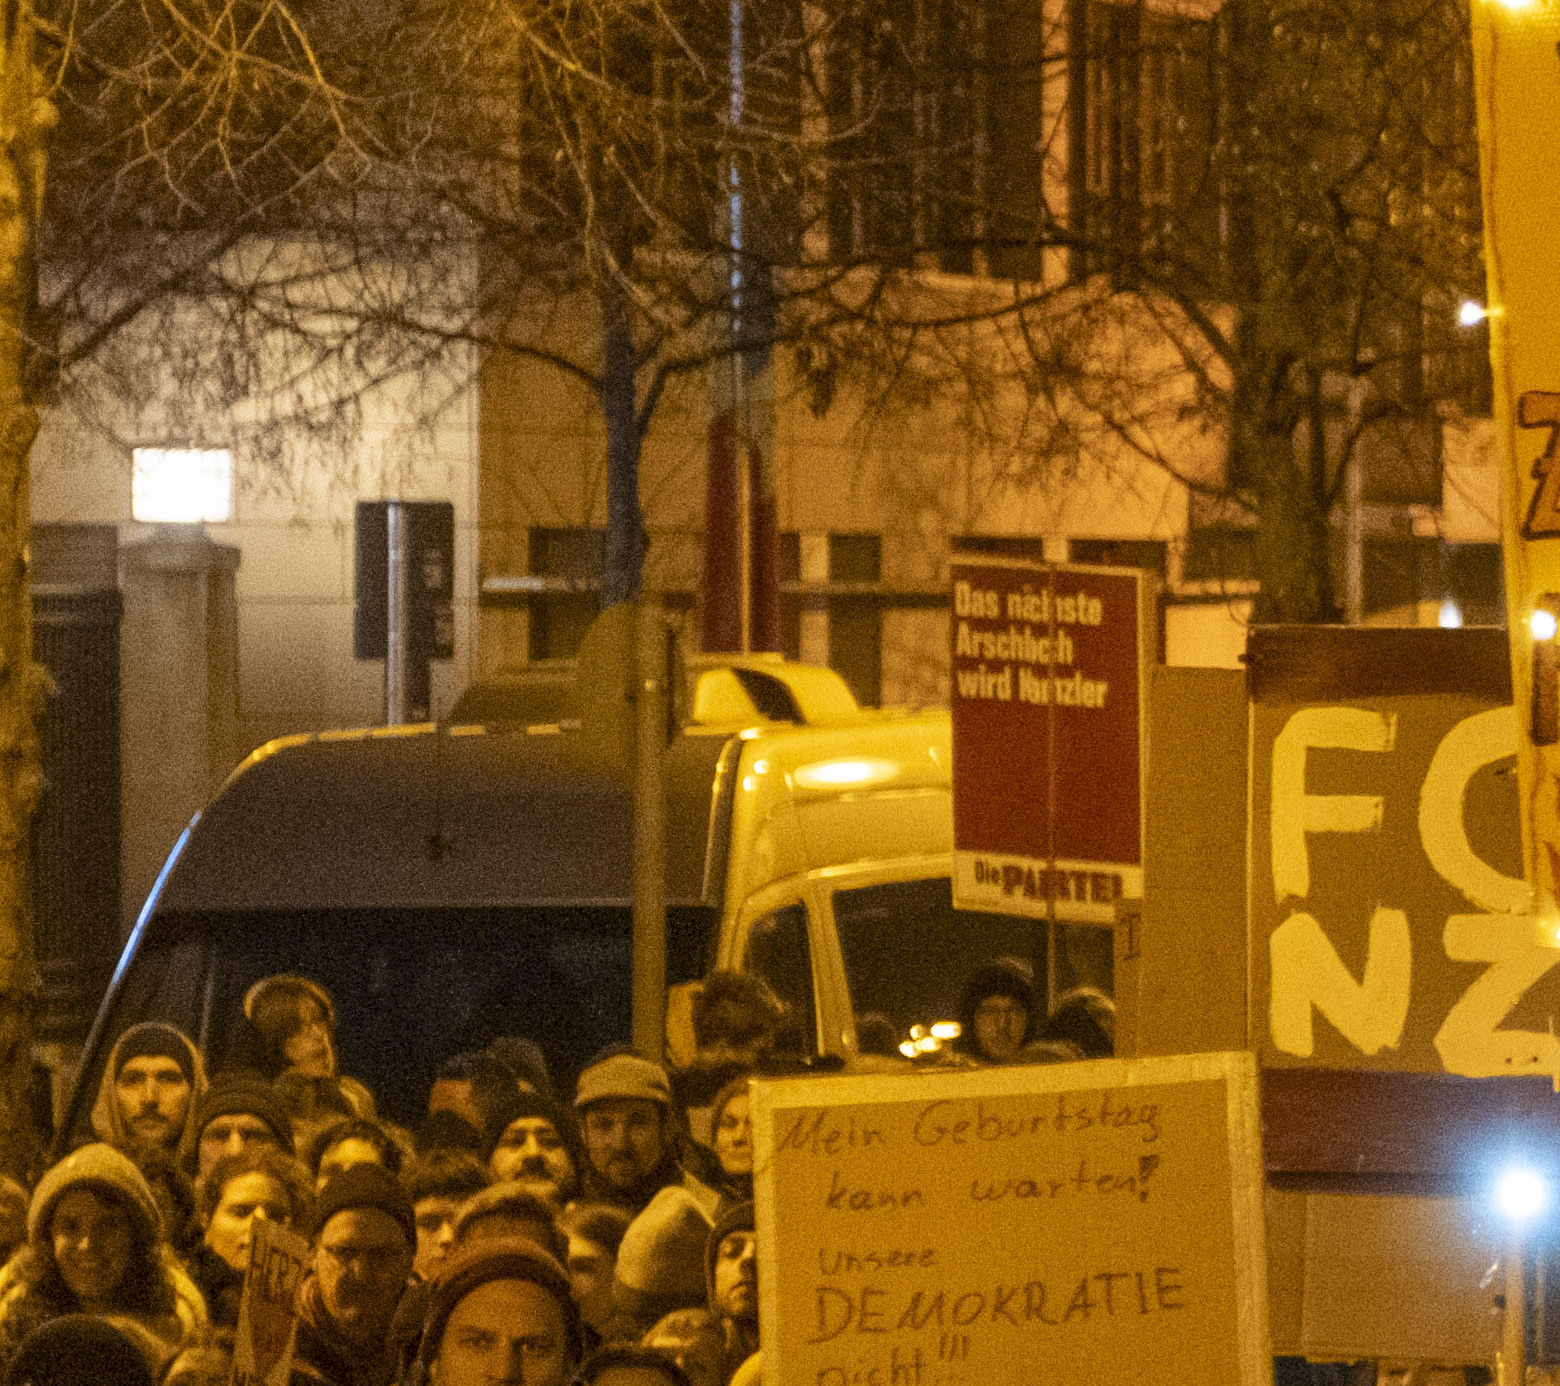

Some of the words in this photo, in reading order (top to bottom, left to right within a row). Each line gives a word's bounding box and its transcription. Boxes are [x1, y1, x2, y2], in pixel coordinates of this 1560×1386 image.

[954, 581, 999, 618] Das
[958, 666, 1011, 701] wird
[973, 859, 1000, 887] Die
[1001, 864, 1124, 906] PARTEI
[775, 1108, 888, 1156] Mein
[911, 1096, 1160, 1148] Geburtstag
[823, 1171, 924, 1212] kann
[970, 1153, 1161, 1204] warten!
[808, 1265, 1187, 1346] DEMOKRATIE
